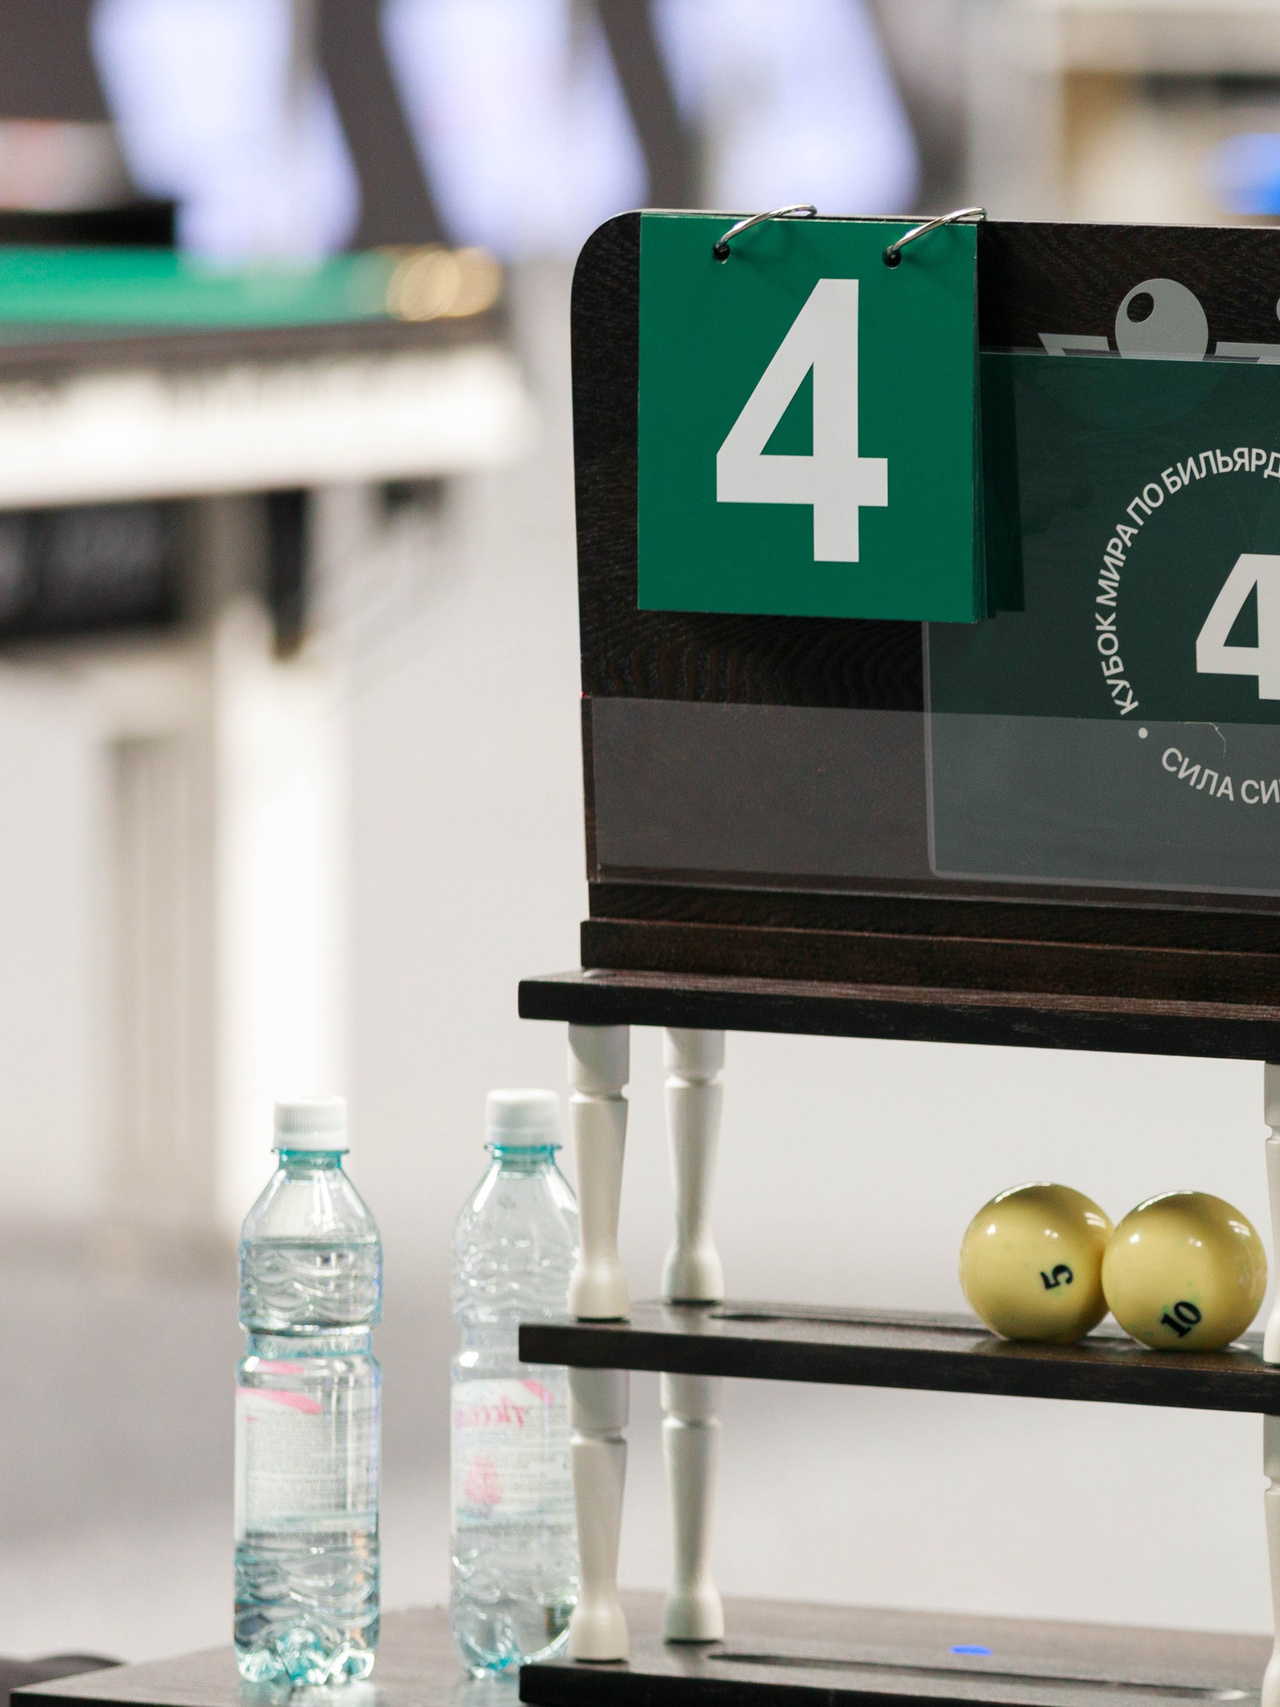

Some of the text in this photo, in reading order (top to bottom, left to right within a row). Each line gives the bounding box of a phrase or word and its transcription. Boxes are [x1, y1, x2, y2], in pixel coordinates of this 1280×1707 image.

[716, 278, 888, 563] 4
[1126, 482, 1165, 526] ПО
[1095, 523, 1138, 607] МИРА
[1095, 612, 1139, 716] КУБОК
[1161, 747, 1235, 801] СИЛА
[1040, 1264, 1074, 1290] 5
[1160, 1301, 1202, 1338] 10
